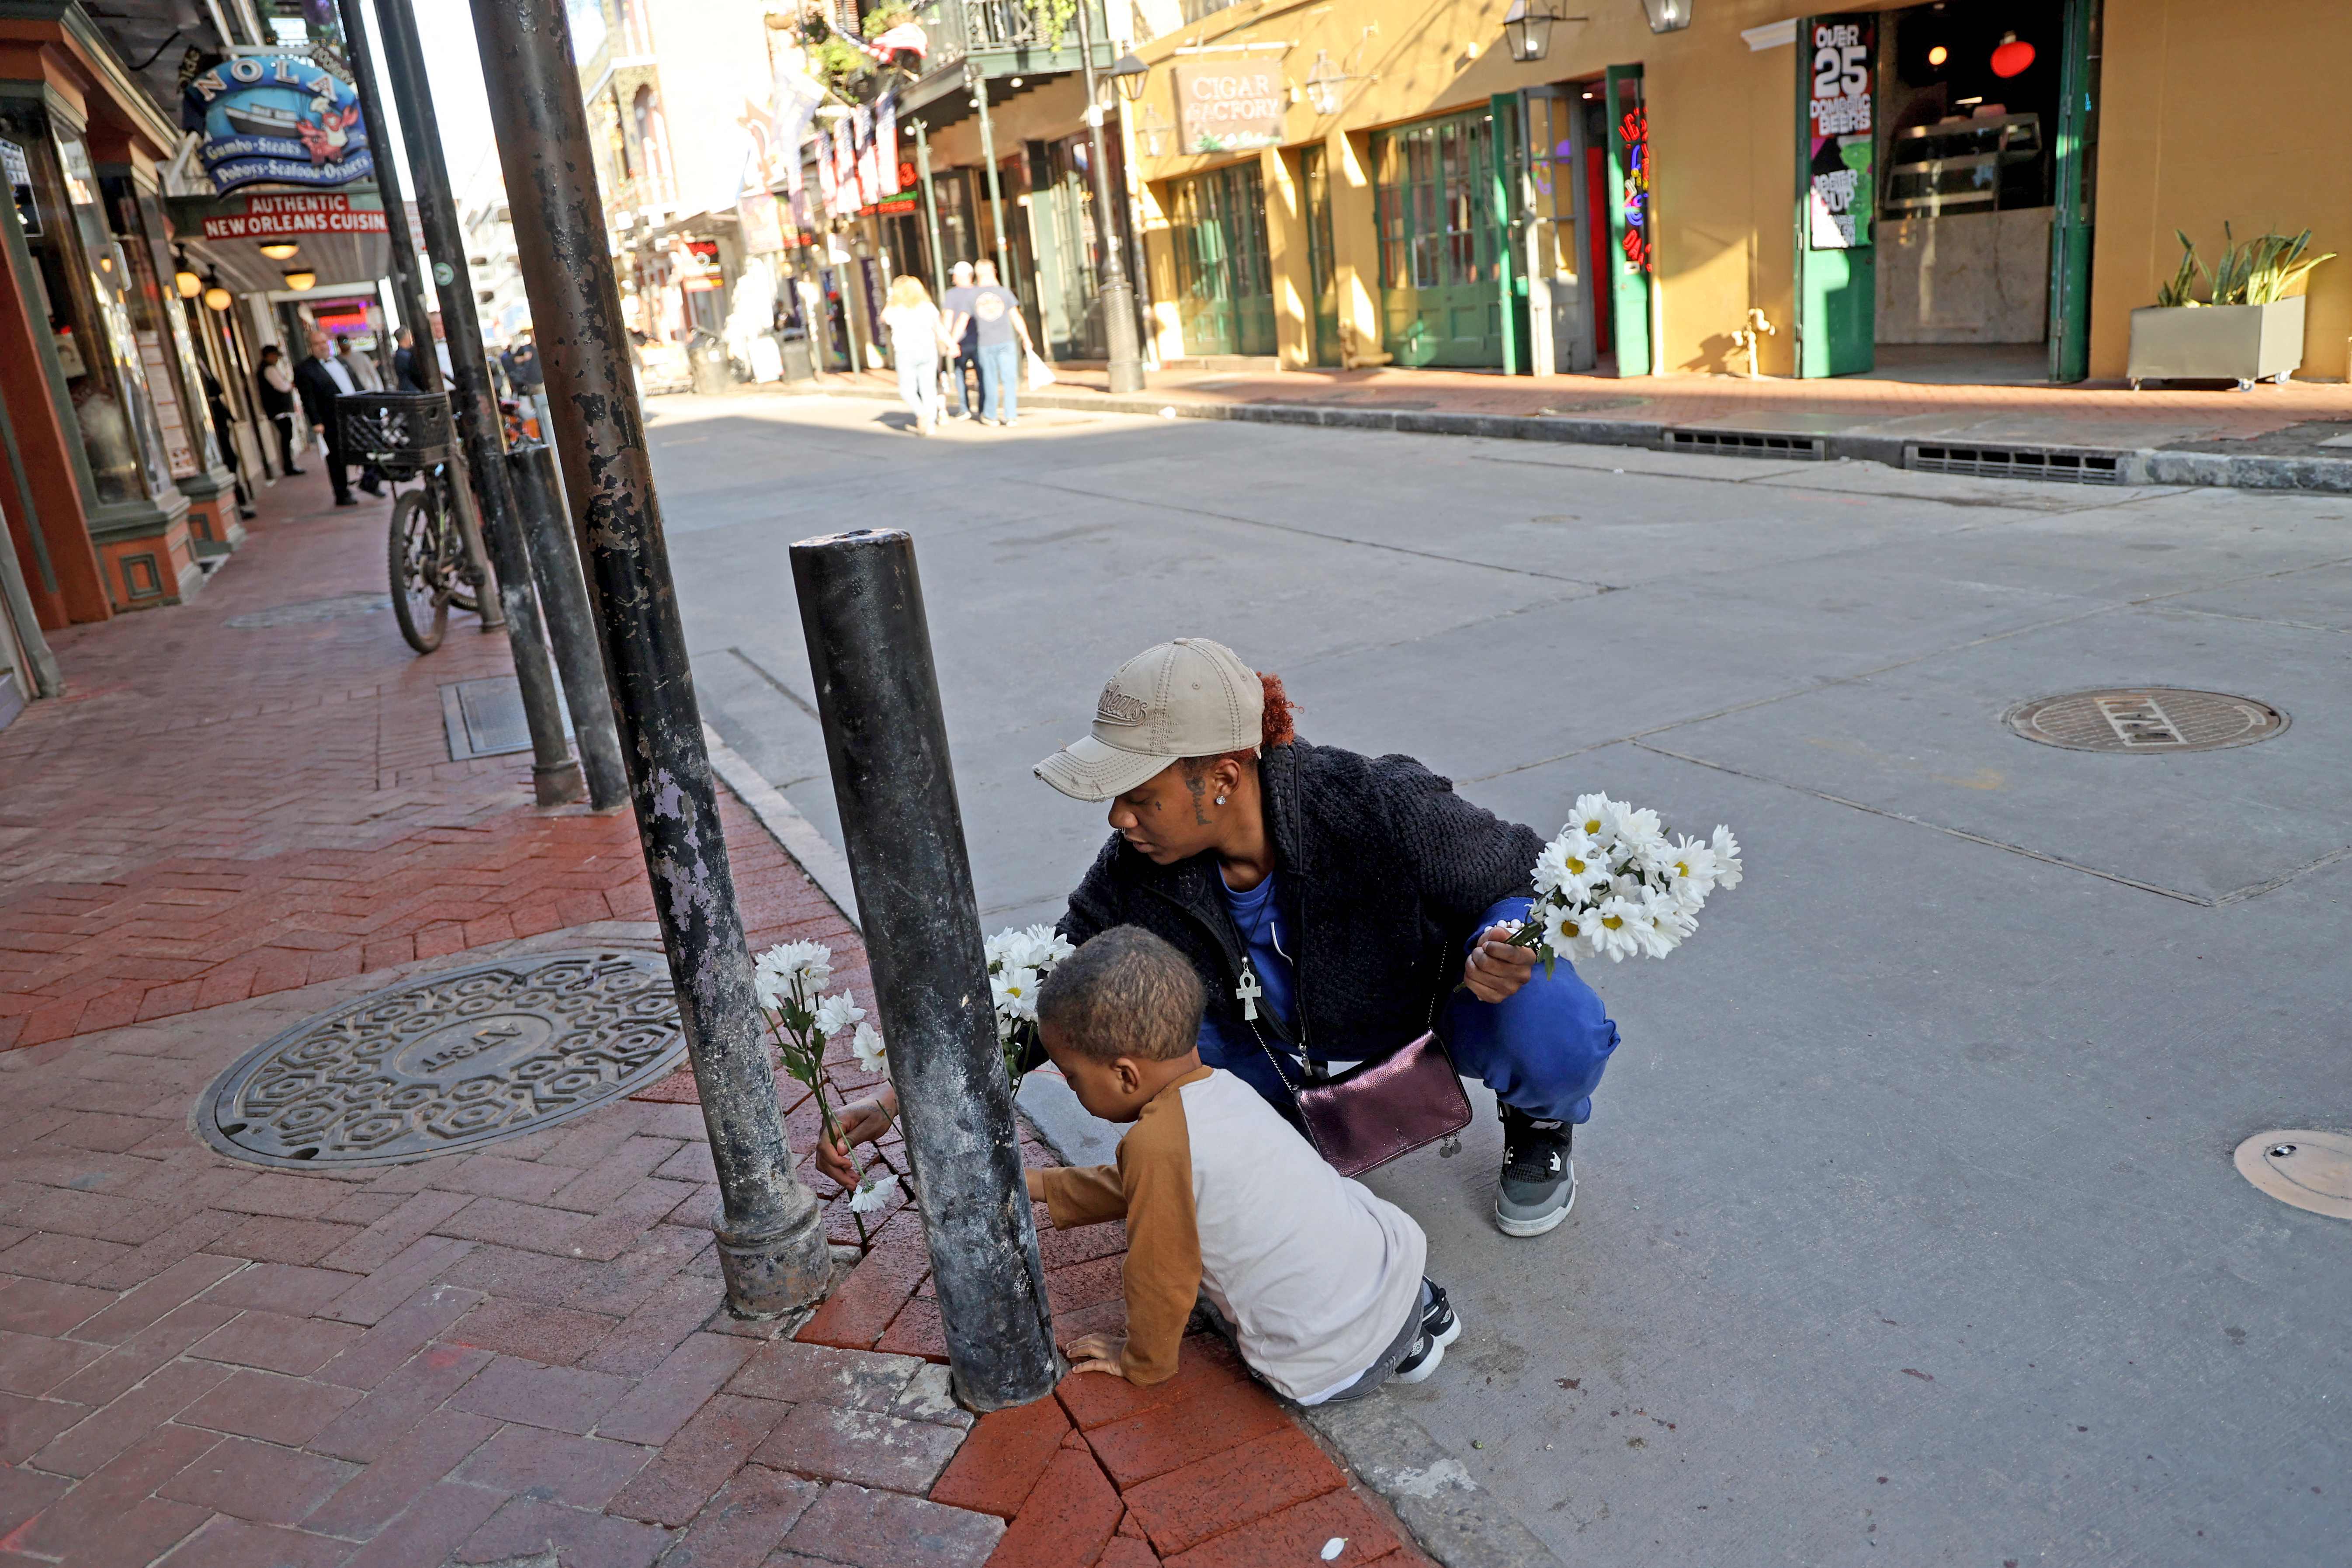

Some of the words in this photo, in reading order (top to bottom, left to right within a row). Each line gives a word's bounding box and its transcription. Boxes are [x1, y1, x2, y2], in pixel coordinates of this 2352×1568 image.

[1816, 25, 1859, 49] OVER
[193, 59, 339, 102] NOLA
[1814, 45, 1867, 98] 25
[1192, 74, 1270, 101] CIGAR
[1186, 98, 1278, 122] FACTORY
[1809, 93, 1871, 118] DOMESTIC
[1818, 110, 1871, 135] BEERS
[258, 137, 301, 155] Steaks
[252, 195, 346, 214] AUTHENTIC
[205, 219, 246, 237] NEW
[248, 214, 328, 232] ORLEANS
[330, 213, 387, 231] CUISIN
